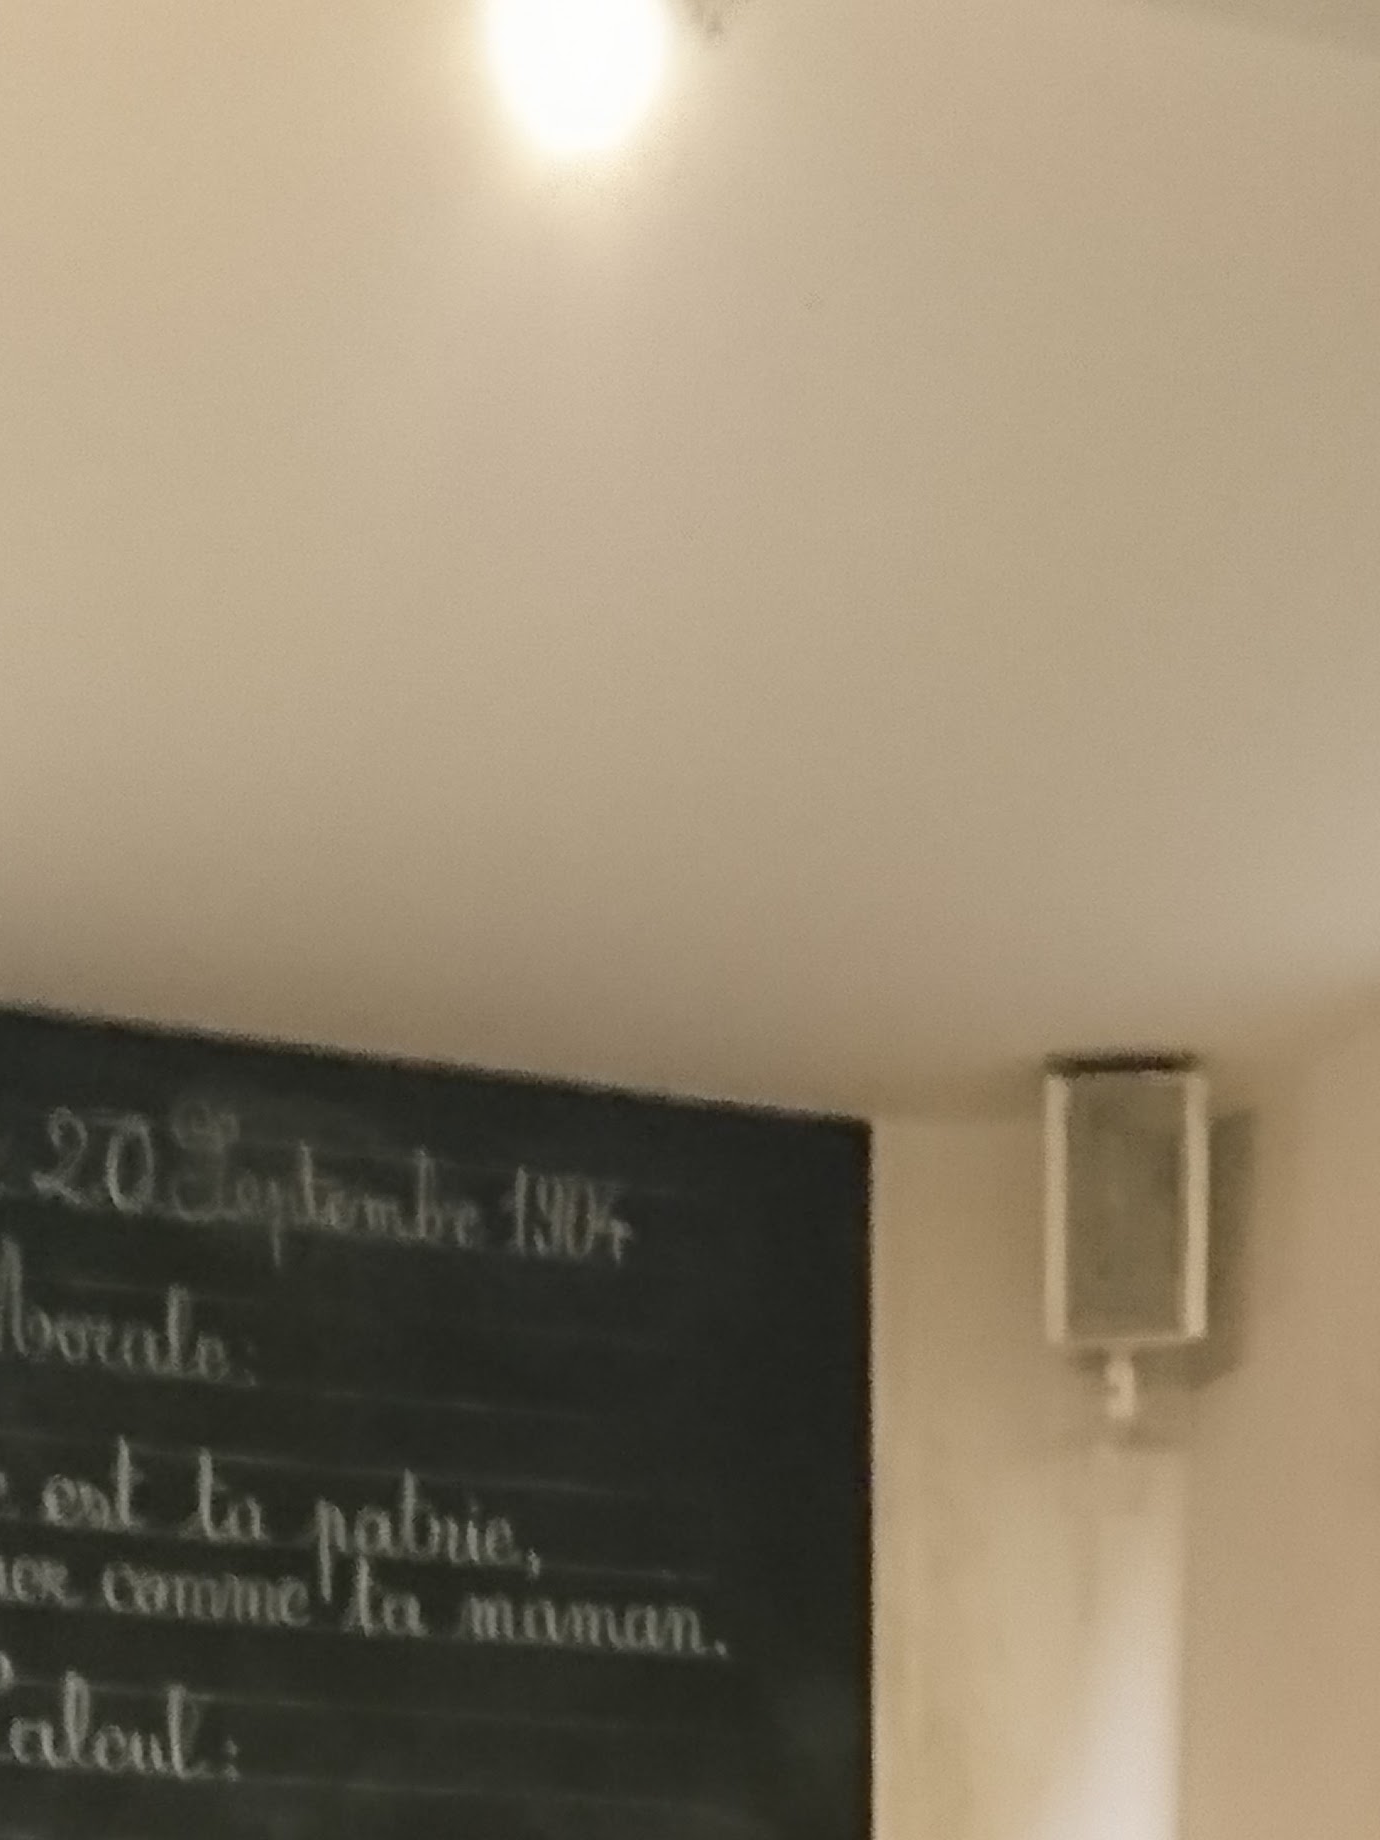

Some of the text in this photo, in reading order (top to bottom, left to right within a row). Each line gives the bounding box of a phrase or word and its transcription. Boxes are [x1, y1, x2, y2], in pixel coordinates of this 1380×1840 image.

[33, 1107, 154, 1214] 20
[42, 1435, 140, 1531] est
[185, 1447, 264, 1542] ta
[102, 1562, 312, 1628] comme
[346, 1557, 423, 1638] ta
[466, 1593, 728, 1658] maman.
